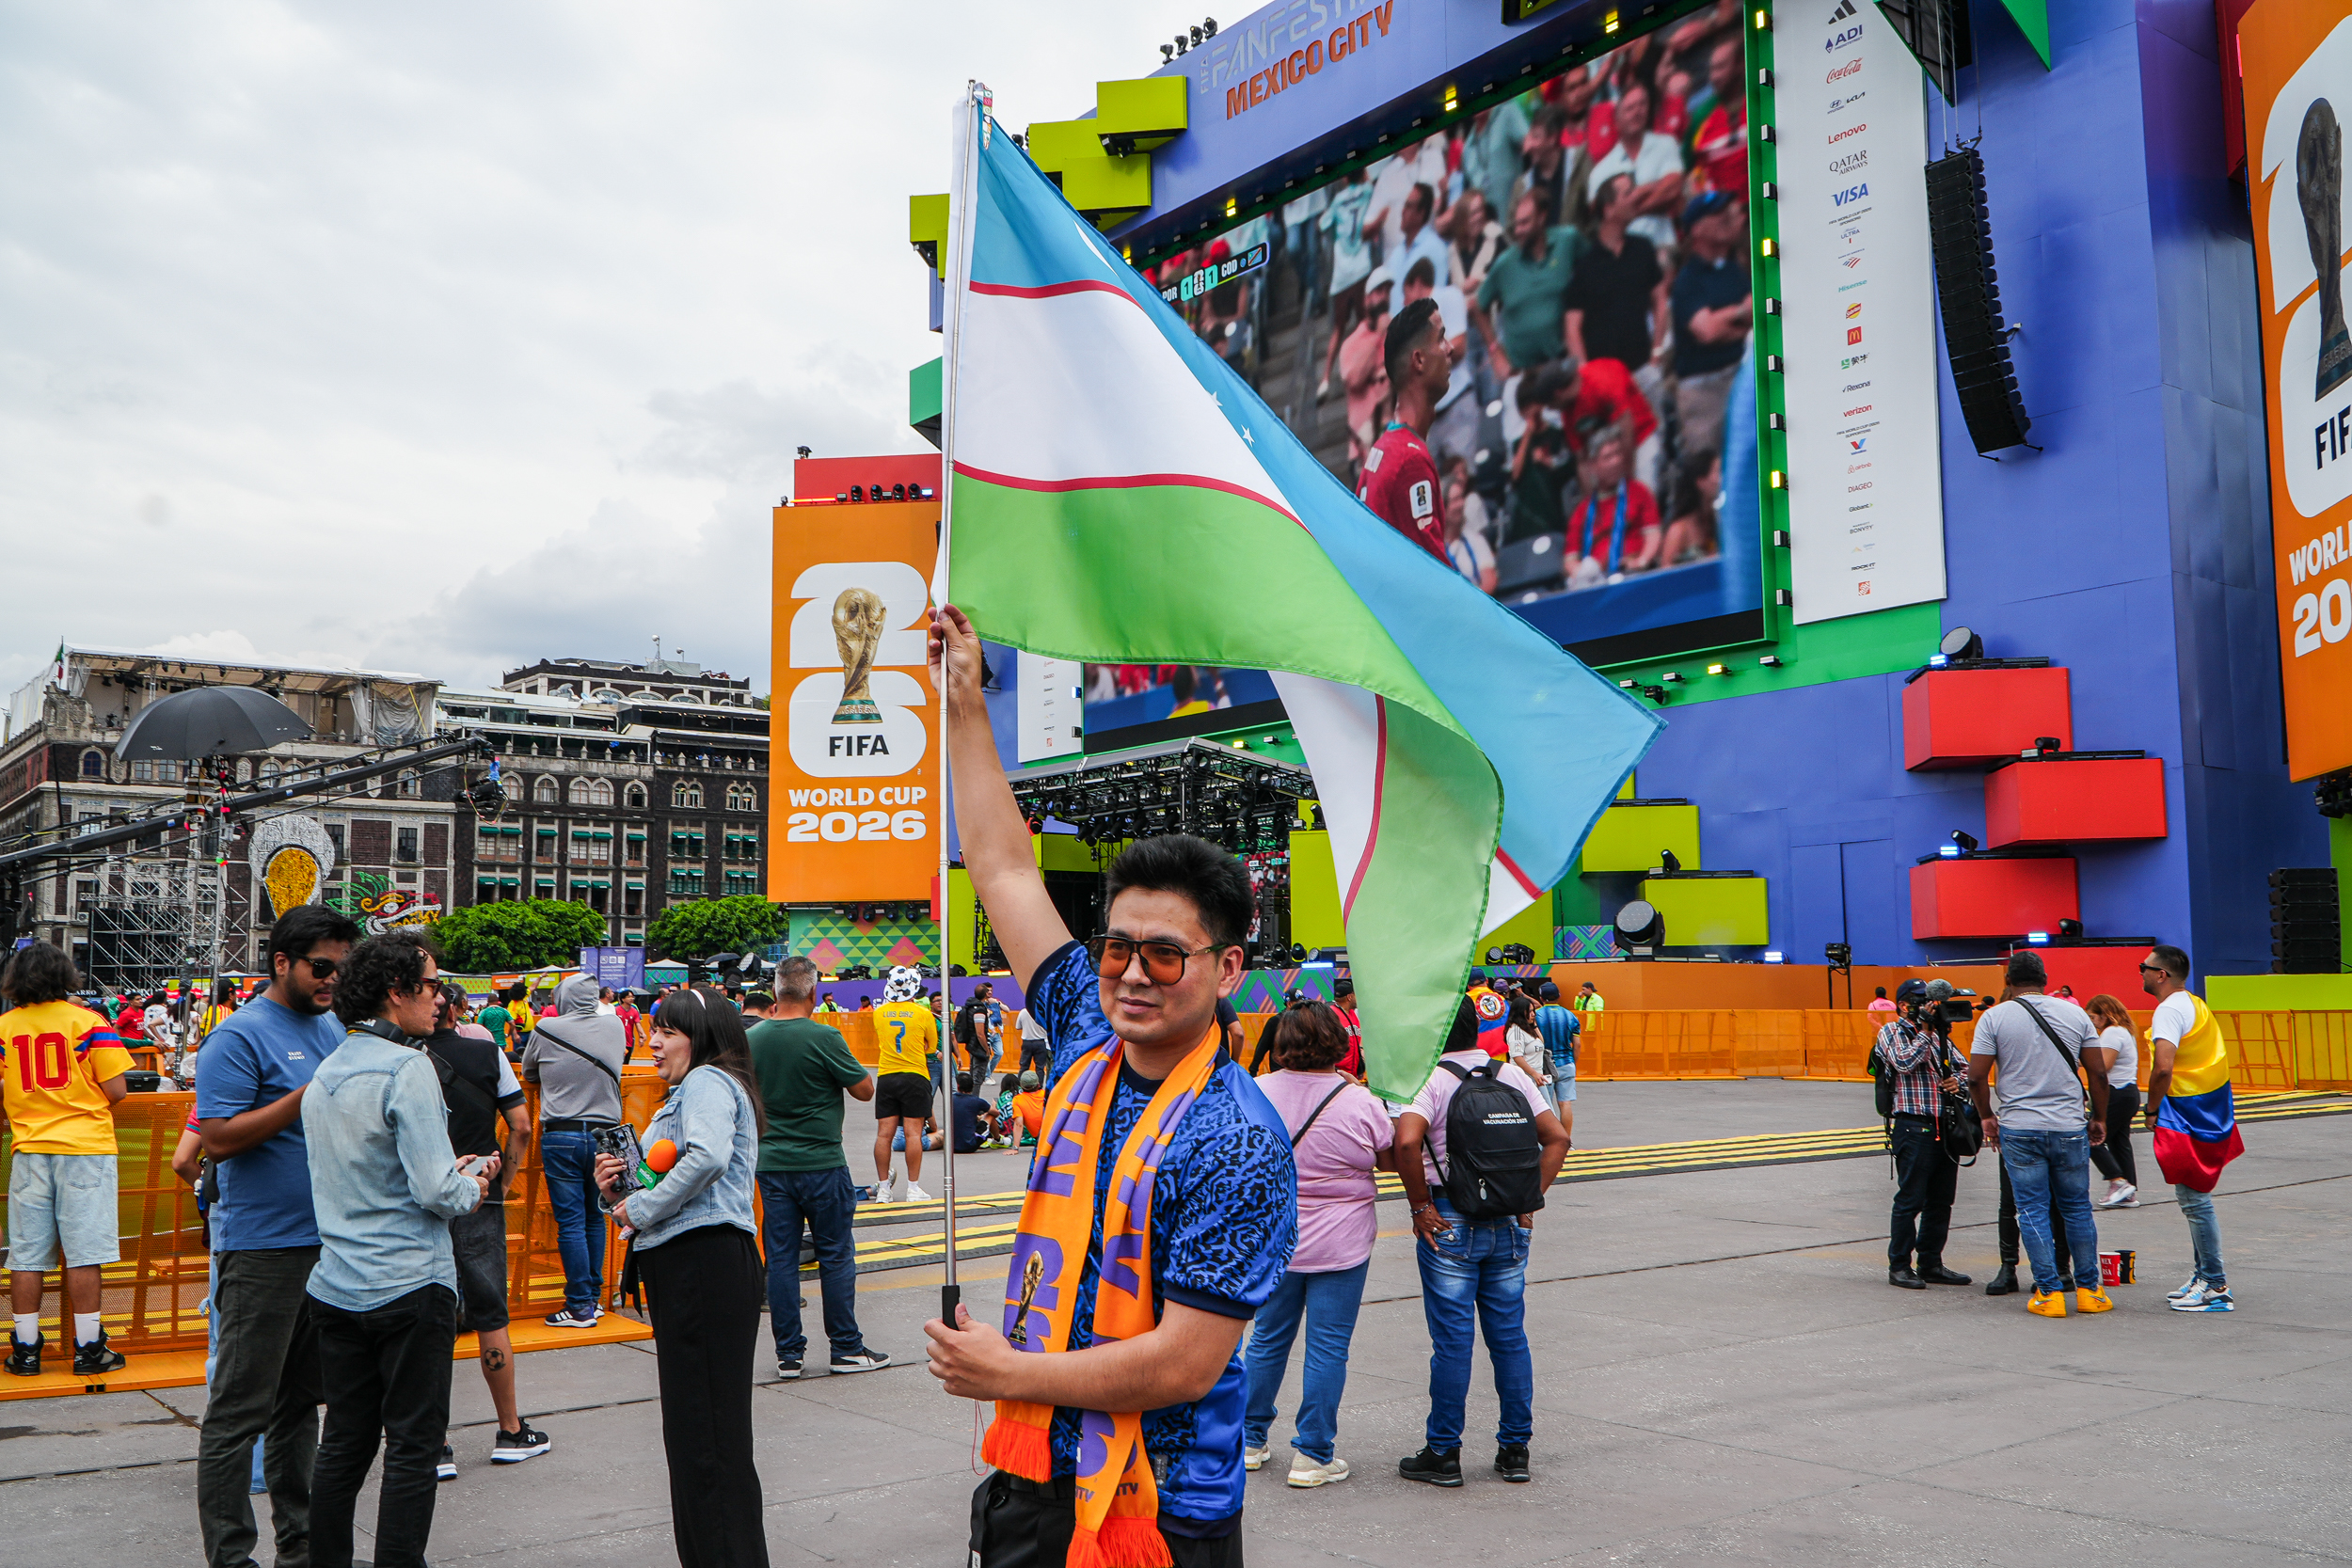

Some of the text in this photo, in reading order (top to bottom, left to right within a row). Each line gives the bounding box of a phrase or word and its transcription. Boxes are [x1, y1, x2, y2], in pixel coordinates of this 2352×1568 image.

[1836, 24, 1863, 46] ADI
[1227, 0, 1394, 120] MEXICO CITY
[1828, 123, 1867, 144] Lenovo
[1829, 150, 1867, 172] QATAR
[1839, 160, 1868, 176] AIRWAYS
[1831, 182, 1868, 207] VISA
[1840, 229, 1860, 239] ULTRA
[1221, 259, 1237, 277] COD
[1838, 279, 1867, 293] Hisense
[1847, 380, 1871, 392] Rexona
[1843, 404, 1872, 417] verizon
[2314, 404, 2352, 470] FIF
[1848, 481, 1873, 493] DIAGEO
[2289, 519, 2352, 586] WORL
[2293, 578, 2352, 658] 20
[829, 735, 890, 757] FIFA
[788, 786, 928, 807] WORLD CUP
[787, 810, 927, 842] 2026
[890, 1021, 906, 1053] 7
[12, 1032, 72, 1093] 10
